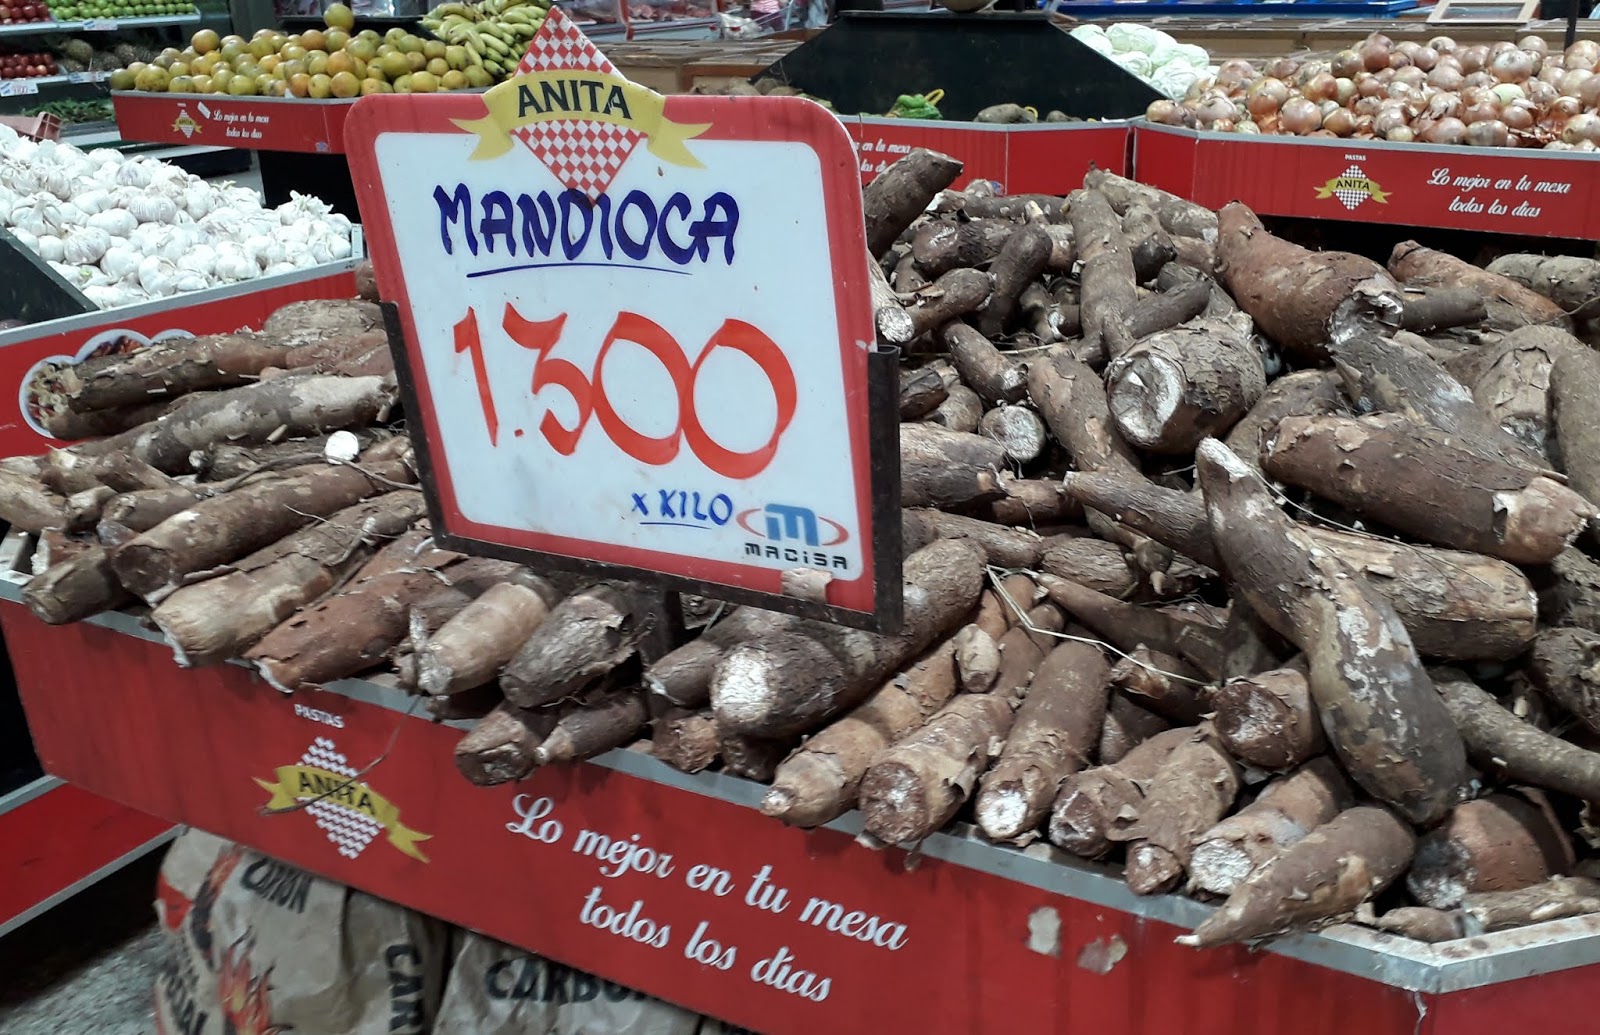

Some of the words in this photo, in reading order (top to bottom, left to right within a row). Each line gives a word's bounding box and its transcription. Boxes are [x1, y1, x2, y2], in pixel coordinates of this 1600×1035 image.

[516, 79, 633, 120] ANITA
[1335, 179, 1370, 191] ANITA
[1426, 167, 1450, 186] Lo
[1453, 174, 1491, 192] mejor
[1494, 178, 1512, 190] en
[1515, 174, 1532, 192] tu
[1534, 181, 1572, 195] mesa
[433, 181, 740, 266] MANDIOCA
[1448, 195, 1484, 214] todos
[1488, 197, 1508, 216] los
[452, 301, 798, 480] 1.300
[658, 488, 733, 526] KILO
[293, 703, 345, 729] PASTAS
[297, 770, 377, 816] ANITA
[504, 793, 563, 844] Lo
[572, 826, 677, 878] mejor
[685, 862, 736, 898] en
[743, 864, 791, 915] tu
[798, 895, 910, 951] mesa
[578, 885, 672, 950] todos
[683, 920, 739, 972] los
[749, 944, 834, 1003] días
